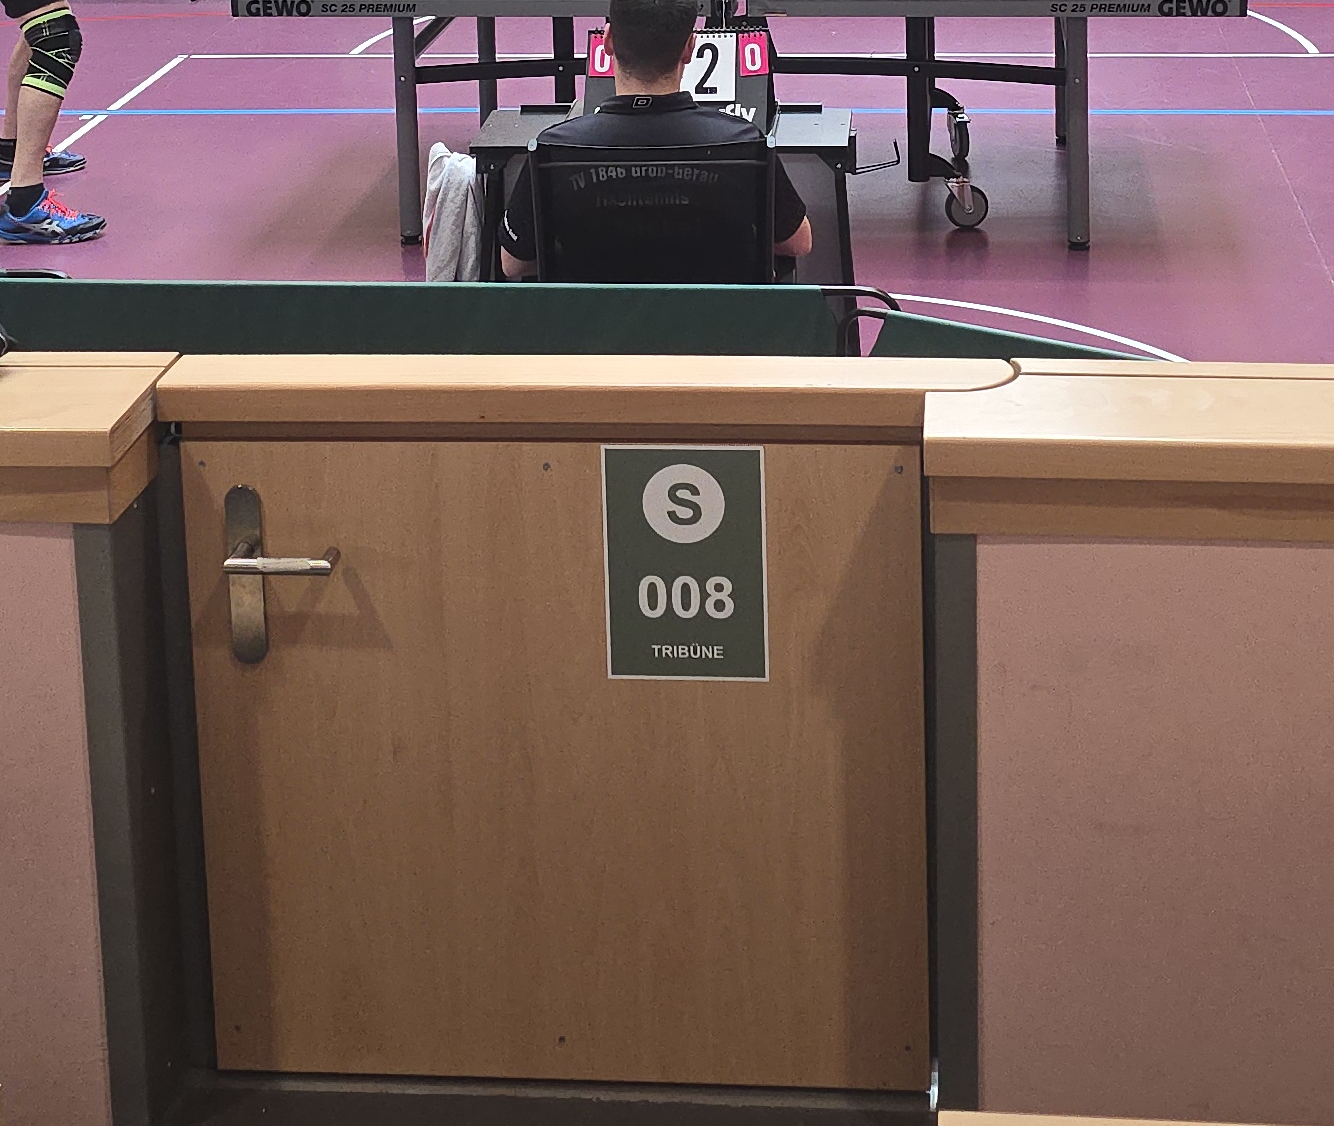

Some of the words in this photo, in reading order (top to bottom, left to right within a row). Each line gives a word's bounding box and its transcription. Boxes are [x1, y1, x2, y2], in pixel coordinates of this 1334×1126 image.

[245, 0, 313, 17] GEWO
[320, 3, 338, 13] SC
[340, 3, 356, 13] 25
[358, 3, 417, 13] PREMIUM
[1049, 3, 1067, 13] SC
[1070, 3, 1087, 13] 25
[1089, 3, 1151, 13] PREMIUM
[1157, 0, 1229, 17] GEWO
[695, 42, 719, 95] 2
[744, 43, 762, 71] 0
[666, 482, 703, 526] S
[638, 574, 735, 619] 008
[651, 642, 725, 660] TRIBÜNE
